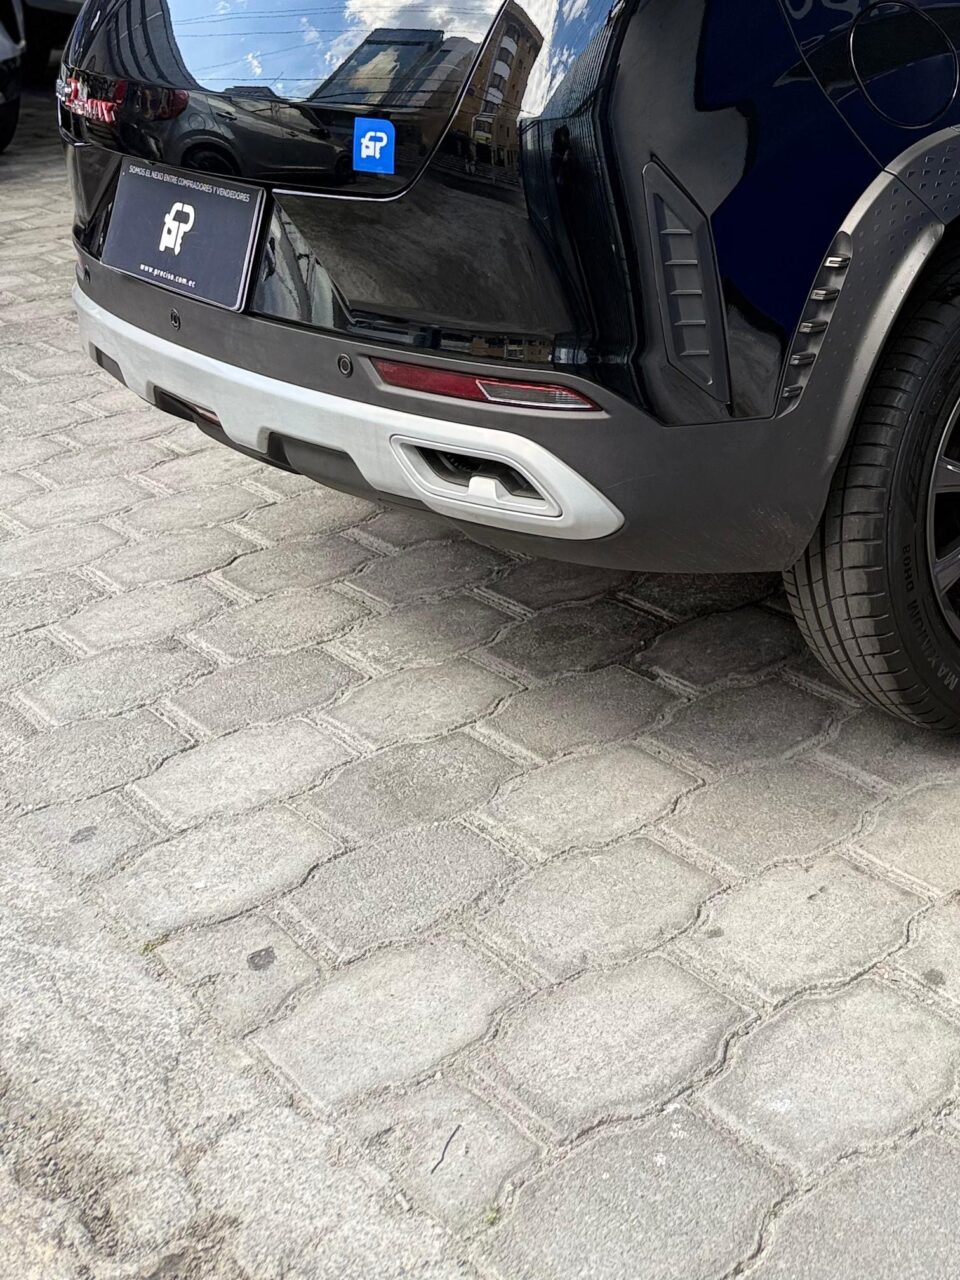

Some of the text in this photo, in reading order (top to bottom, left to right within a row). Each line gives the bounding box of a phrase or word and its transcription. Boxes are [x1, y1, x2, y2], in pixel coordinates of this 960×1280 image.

[129, 165, 145, 176] SOMOS
[145, 169, 151, 178] EL
[151, 170, 164, 181] NEXO
[163, 173, 178, 185] ENTRE
[177, 177, 213, 194] COMPRADORES
[216, 187, 251, 203] VENDEDORES
[140, 264, 196, 288] www.preciso.com.ec
